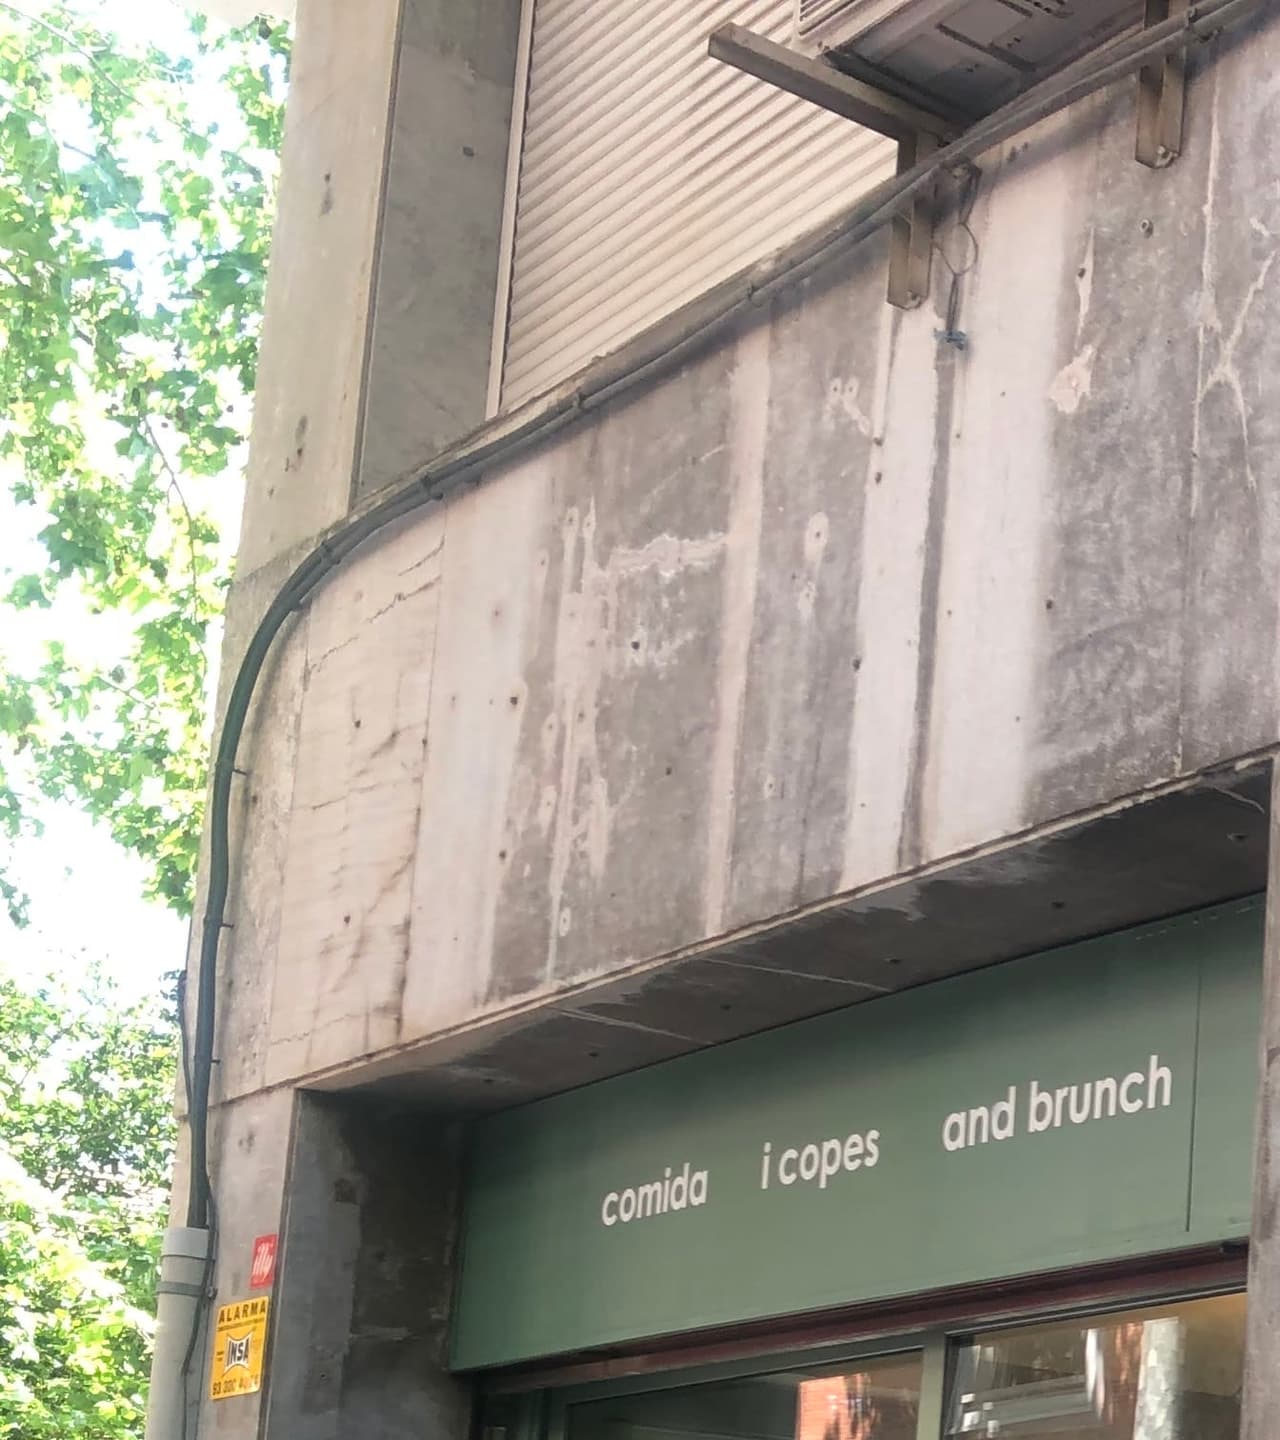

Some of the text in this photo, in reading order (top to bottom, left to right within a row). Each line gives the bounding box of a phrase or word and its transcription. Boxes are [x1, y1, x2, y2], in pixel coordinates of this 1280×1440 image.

[601, 1054, 1173, 1226] comida i copes and brunch
[218, 1299, 266, 1324] ALARMA
